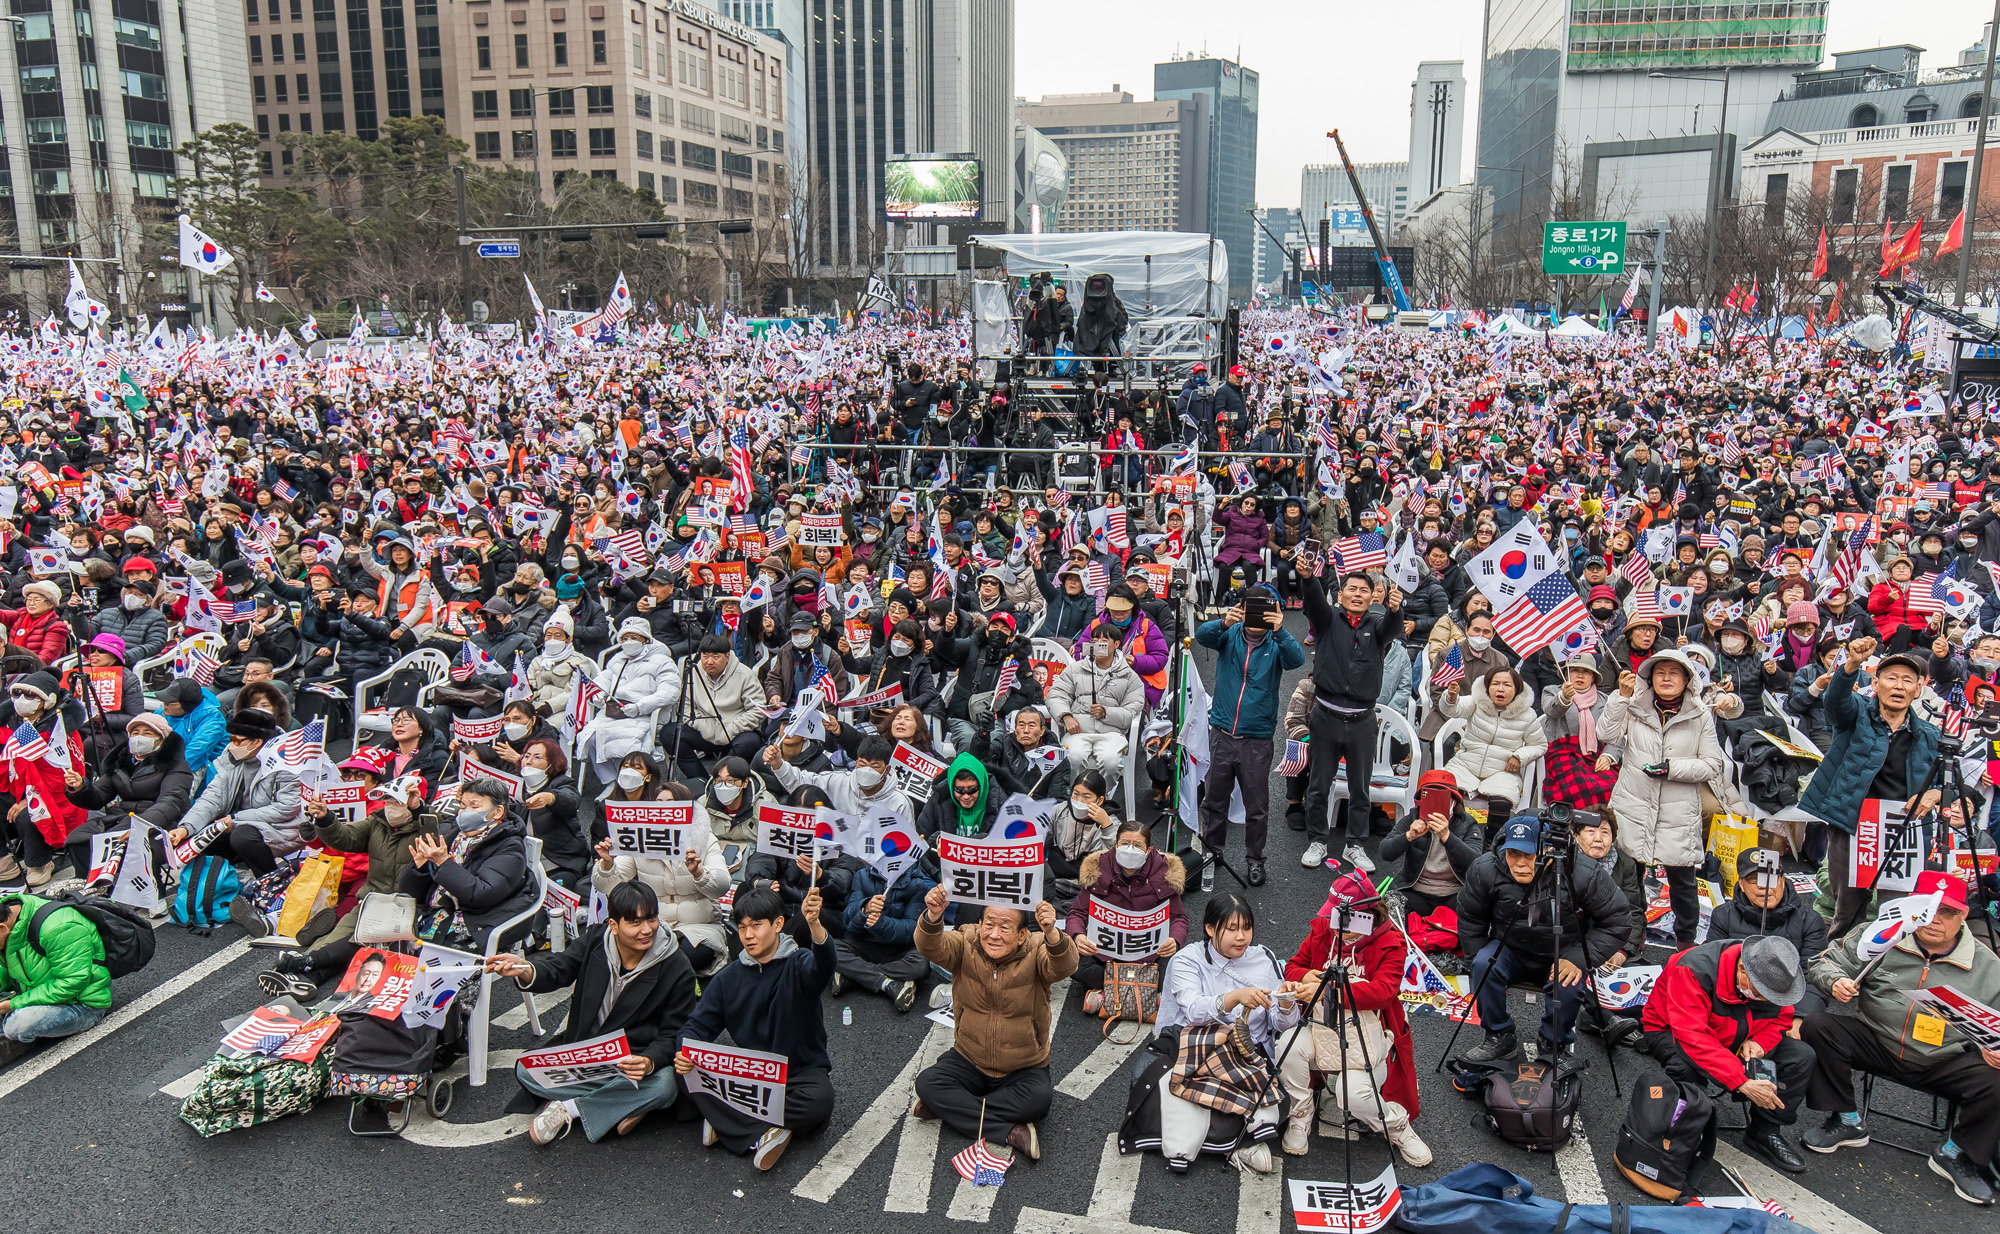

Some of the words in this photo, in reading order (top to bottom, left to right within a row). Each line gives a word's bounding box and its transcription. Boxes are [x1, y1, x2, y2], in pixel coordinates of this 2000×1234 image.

[683, 1, 707, 25] SEOUL
[709, 10, 738, 36] FINANCE
[738, 27, 760, 46] CENTER
[1551, 227, 1617, 243] 종로1가
[1549, 245, 1575, 255] Jongno
[1578, 245, 1601, 255] 1(il)-ga
[1585, 258, 1592, 266] 6
[161, 303, 186, 311] Frisbee
[1175, 484, 1192, 493] 원천
[802, 517, 840, 526] 자유민주주의
[804, 528, 837, 544] 회복!
[719, 573, 743, 584] 원천
[1148, 573, 1167, 586] 원천
[721, 583, 744, 594] 무효
[906, 752, 938, 779] 주사파
[611, 807, 687, 823] 자유민주주의
[616, 826, 682, 856] 회복!
[1717, 844, 1735, 853] LOVE
[1858, 821, 1878, 867] 주사파
[947, 841, 1039, 864] 자유민주주의
[952, 867, 1034, 905] 회복!
[1093, 904, 1166, 928] 자유민주주의
[1096, 926, 1162, 955] 회복!
[530, 1040, 623, 1066] 자유민주주의
[689, 1050, 781, 1081] 자유민주주의
[698, 1069, 773, 1116] 회복!
[1306, 1182, 1387, 1211] 척결!
[1323, 1211, 1381, 1228] 주사파
